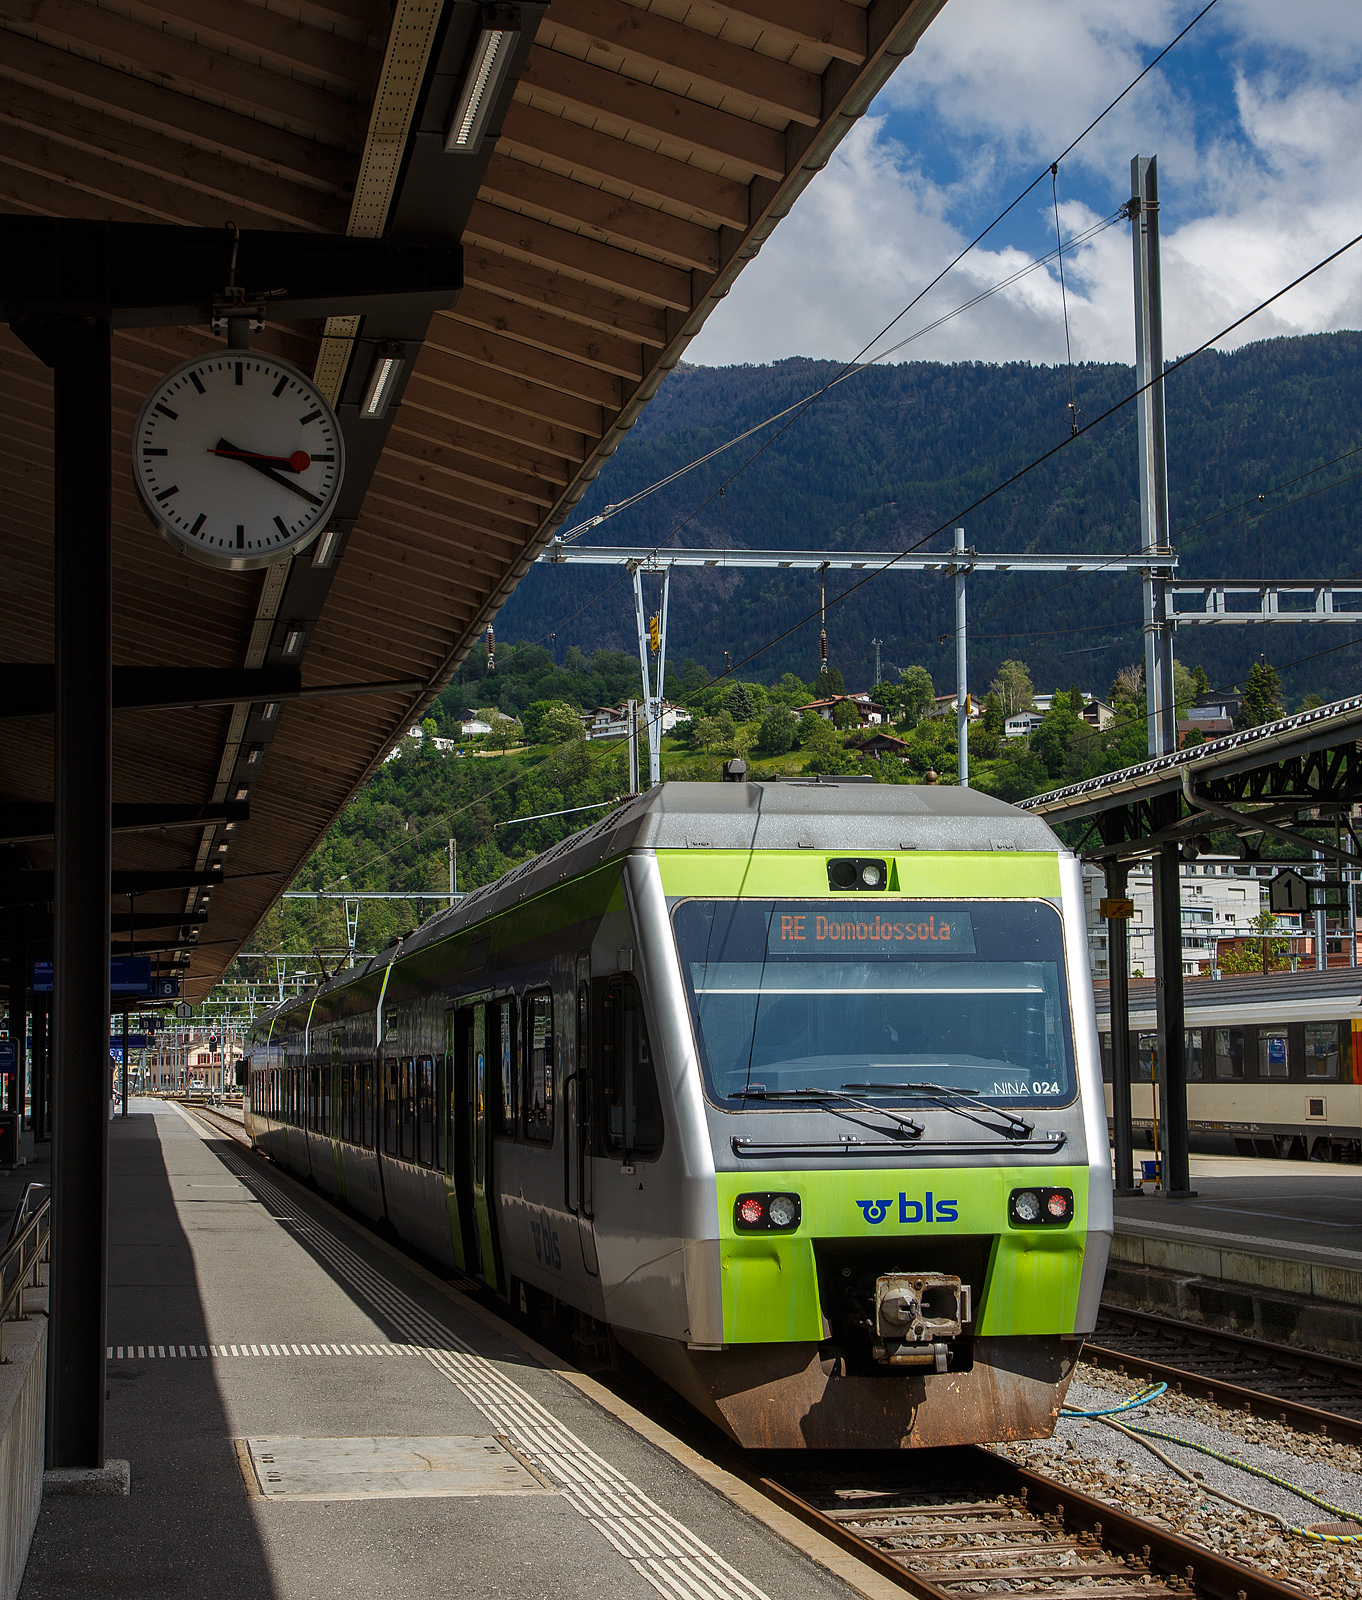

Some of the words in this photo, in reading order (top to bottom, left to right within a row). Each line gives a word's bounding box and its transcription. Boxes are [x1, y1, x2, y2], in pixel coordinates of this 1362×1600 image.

[1283, 878, 1293, 908] 1
[781, 915, 807, 940] RE
[816, 915, 951, 940] Domodossola
[163, 983, 173, 994] 8
[155, 1020, 161, 1028] 8
[993, 1082, 1031, 1095] NINA
[1032, 1081, 1061, 1095] 024
[898, 1191, 959, 1224] bls
[540, 1212, 562, 1271] bls
